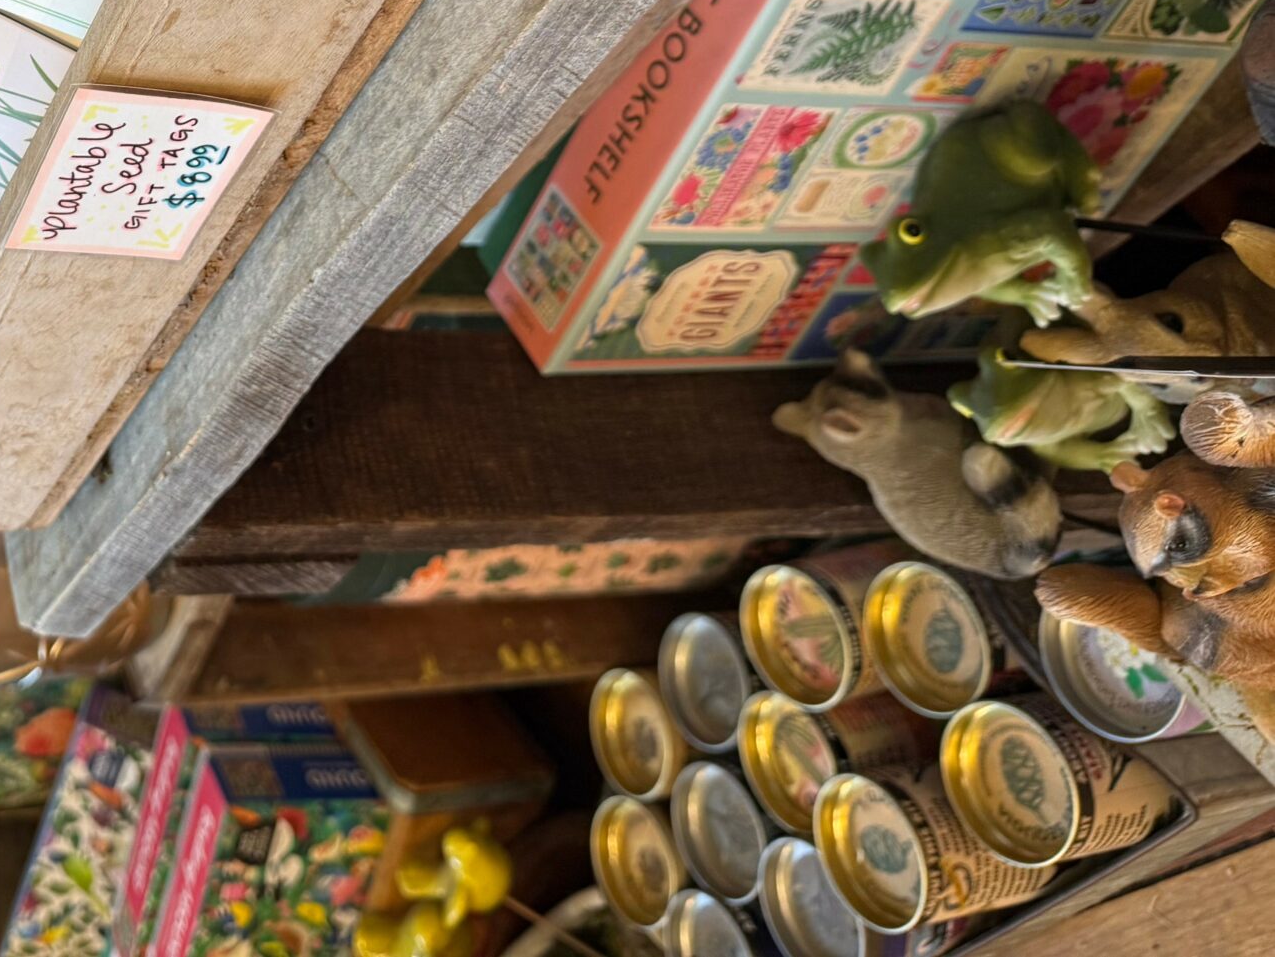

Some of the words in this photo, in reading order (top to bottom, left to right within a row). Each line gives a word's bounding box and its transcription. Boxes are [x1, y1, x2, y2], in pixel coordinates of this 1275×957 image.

[584, 6, 703, 206] BOOKSHELF
[101, 138, 153, 195] Seed
[125, 183, 165, 230] GIFT
[161, 115, 199, 169] TAGS
[679, 261, 761, 341] GIANTS
